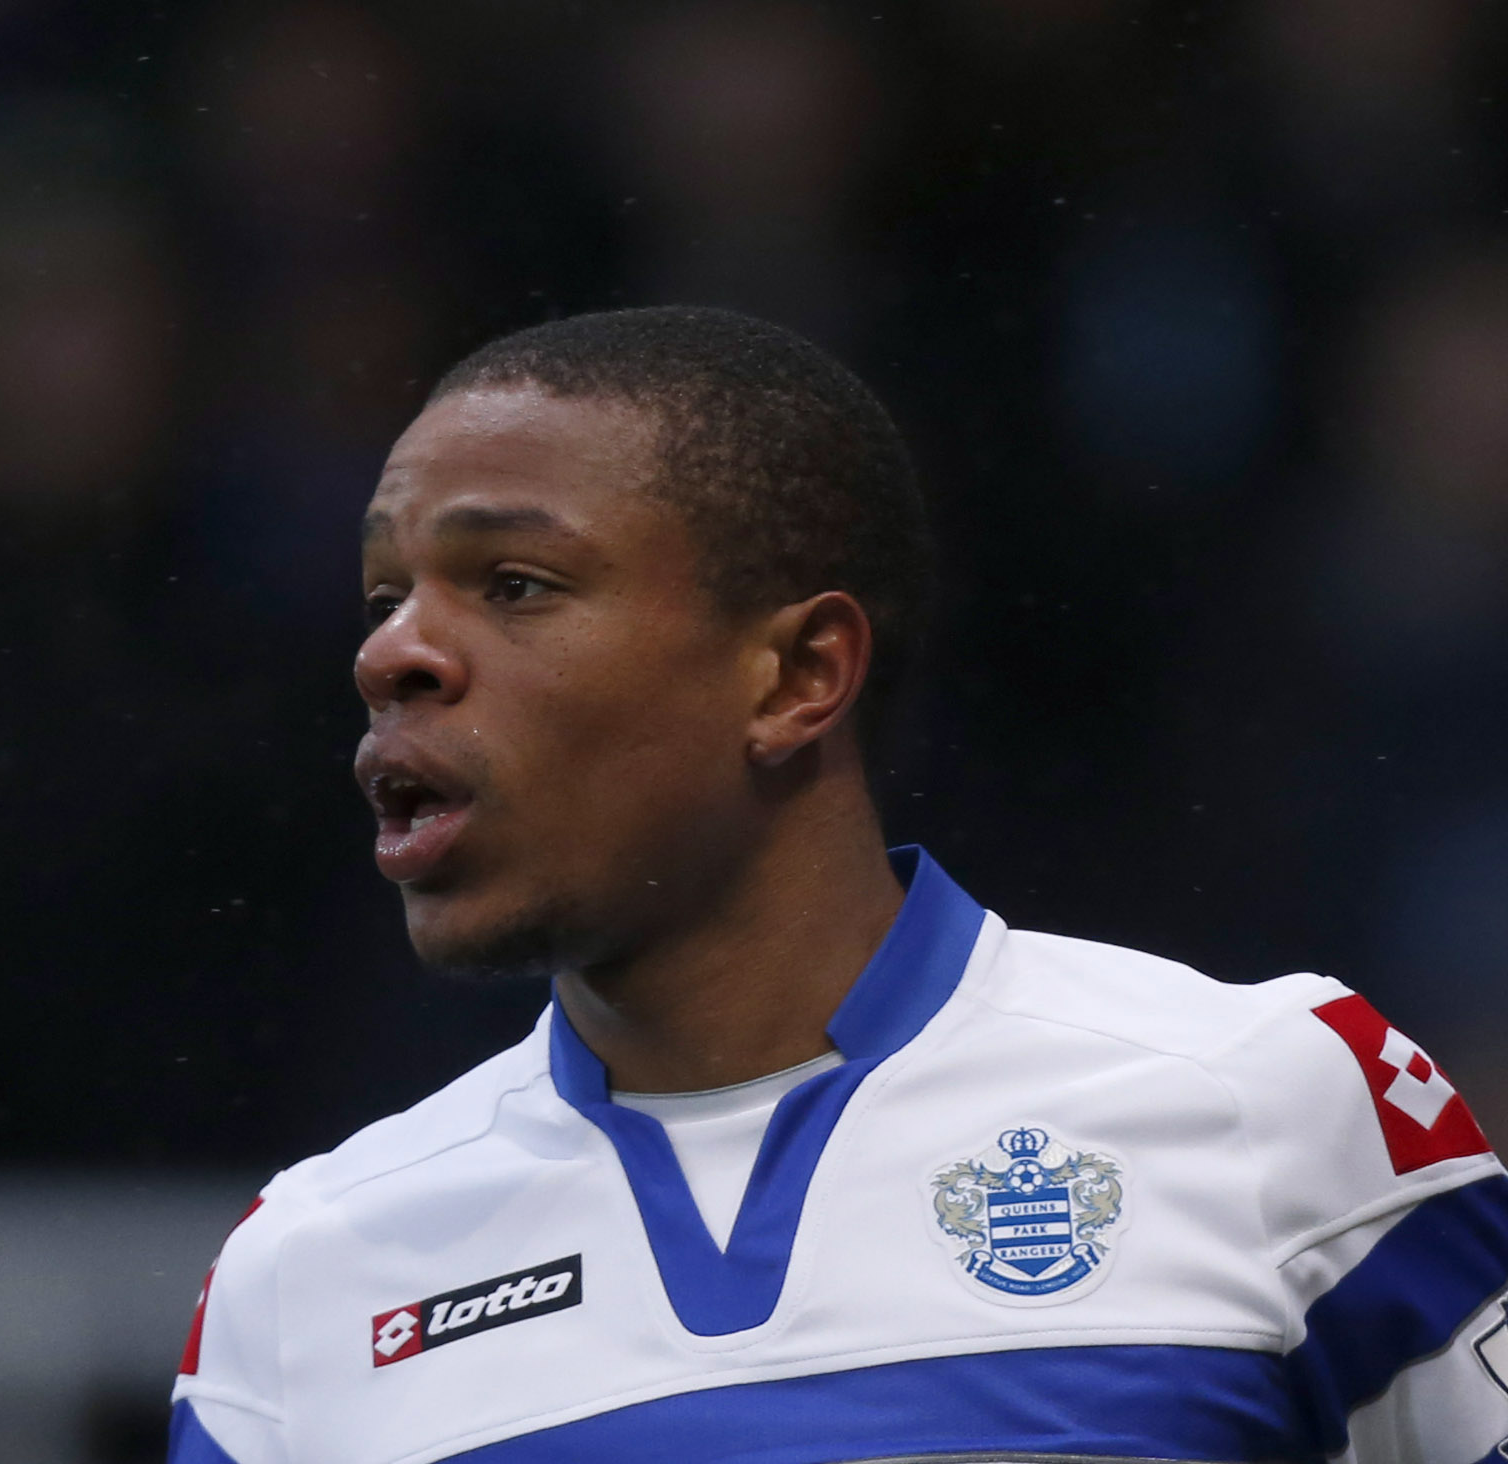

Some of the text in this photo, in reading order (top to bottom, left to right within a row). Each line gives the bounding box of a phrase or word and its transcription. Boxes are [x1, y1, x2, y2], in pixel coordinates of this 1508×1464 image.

[1001, 1203, 1056, 1216] QUEENS
[1013, 1225, 1047, 1236] PARK
[1000, 1246, 1064, 1258] RANGERS
[427, 1271, 574, 1336] lotto
